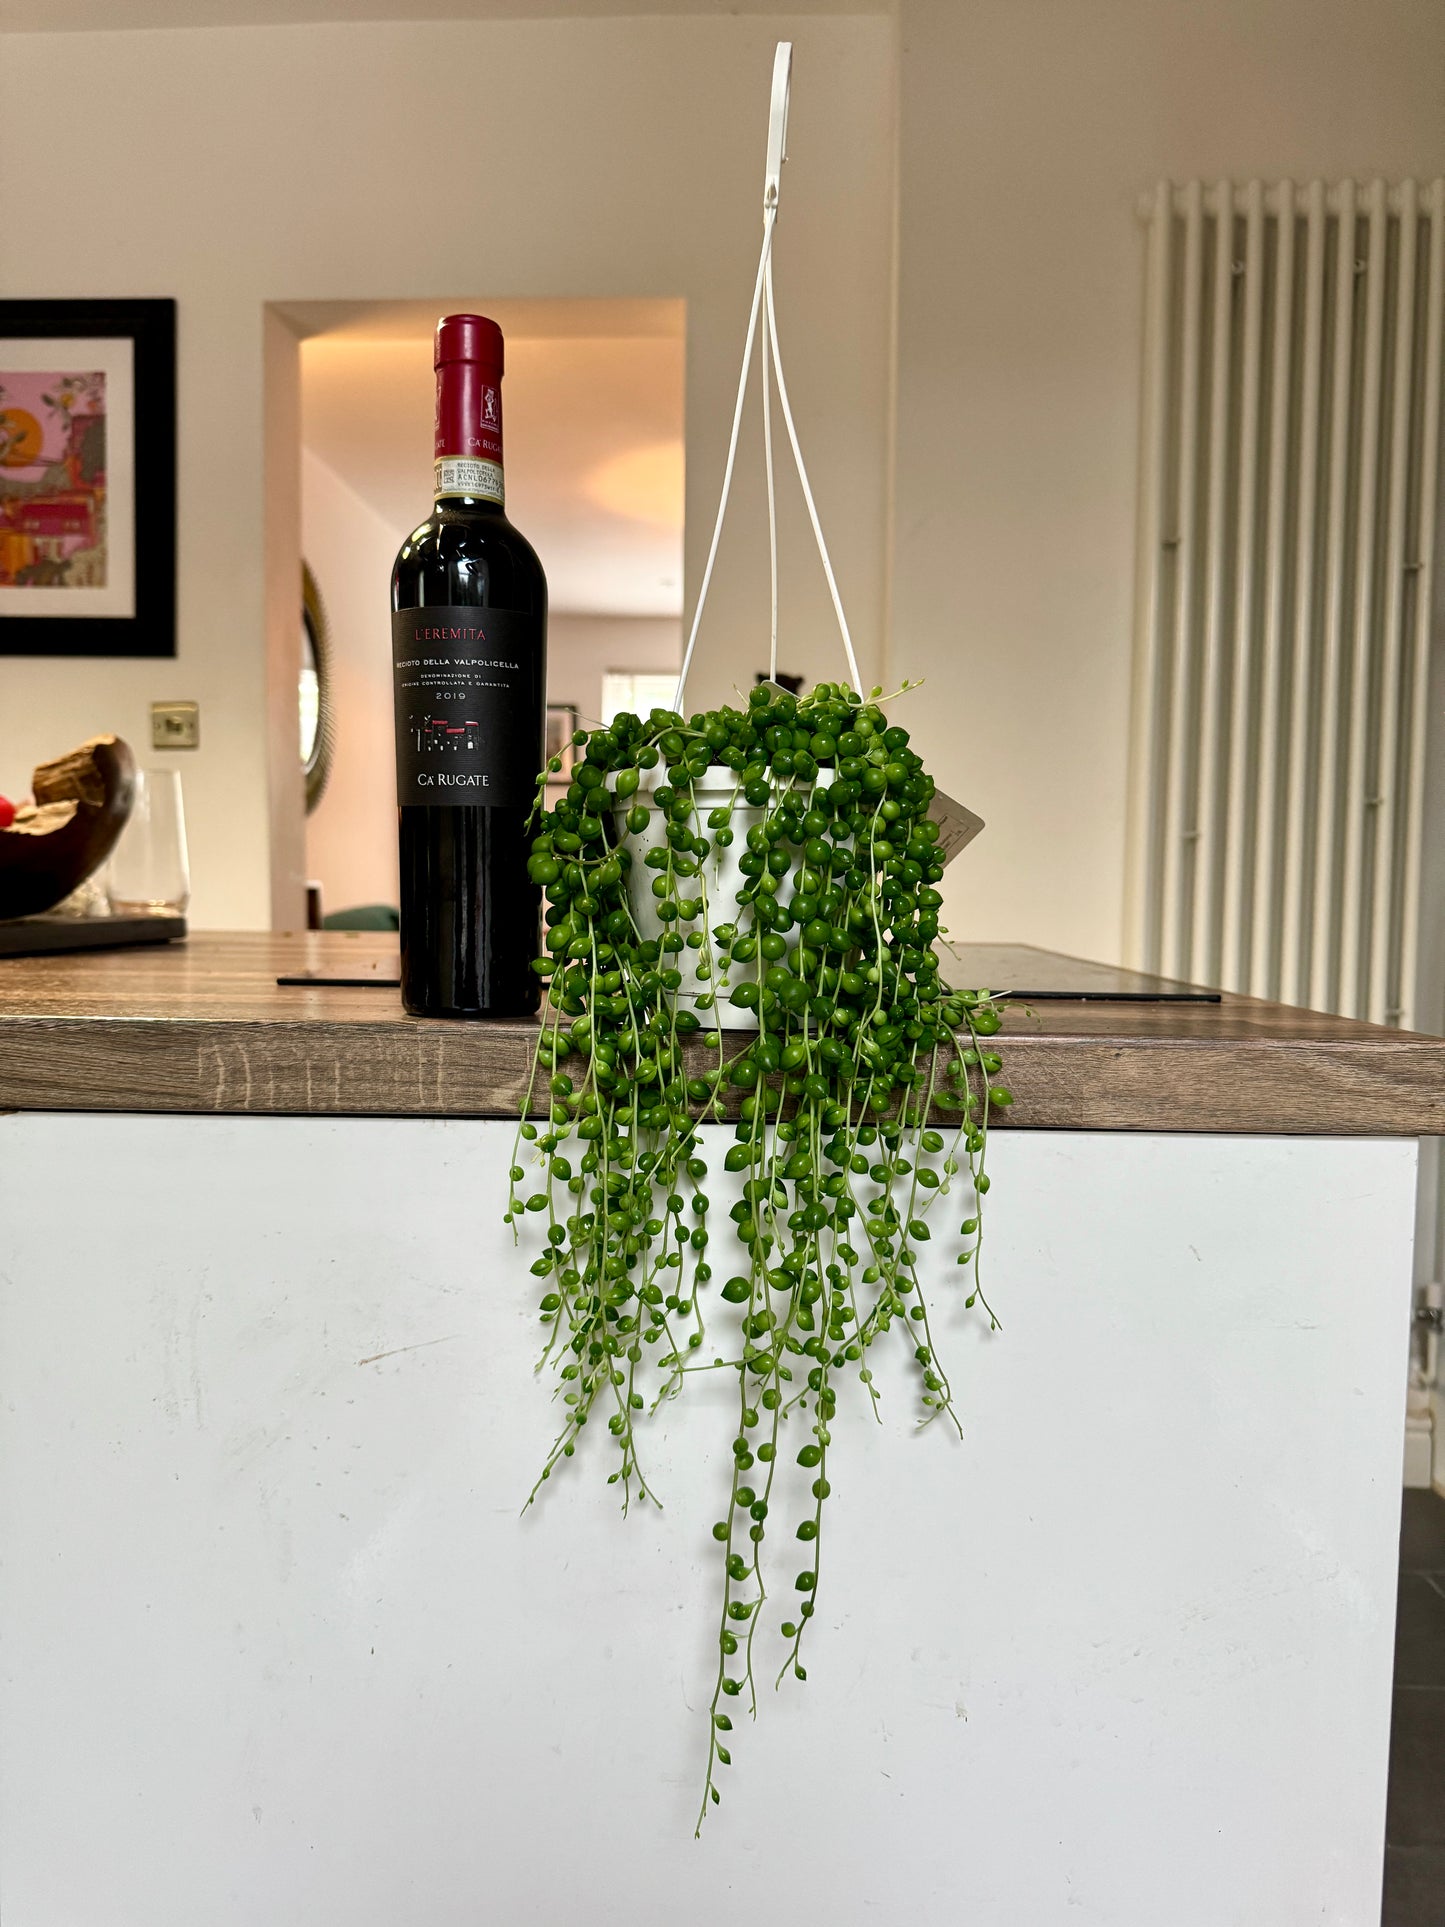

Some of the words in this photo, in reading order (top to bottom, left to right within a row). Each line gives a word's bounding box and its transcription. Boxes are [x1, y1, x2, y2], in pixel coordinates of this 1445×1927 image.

[415, 627, 486, 641] L'EREMITA
[454, 659, 520, 670] VALPOLICELLA
[436, 692, 466, 700] 2019
[437, 773, 490, 787] RUGATE
